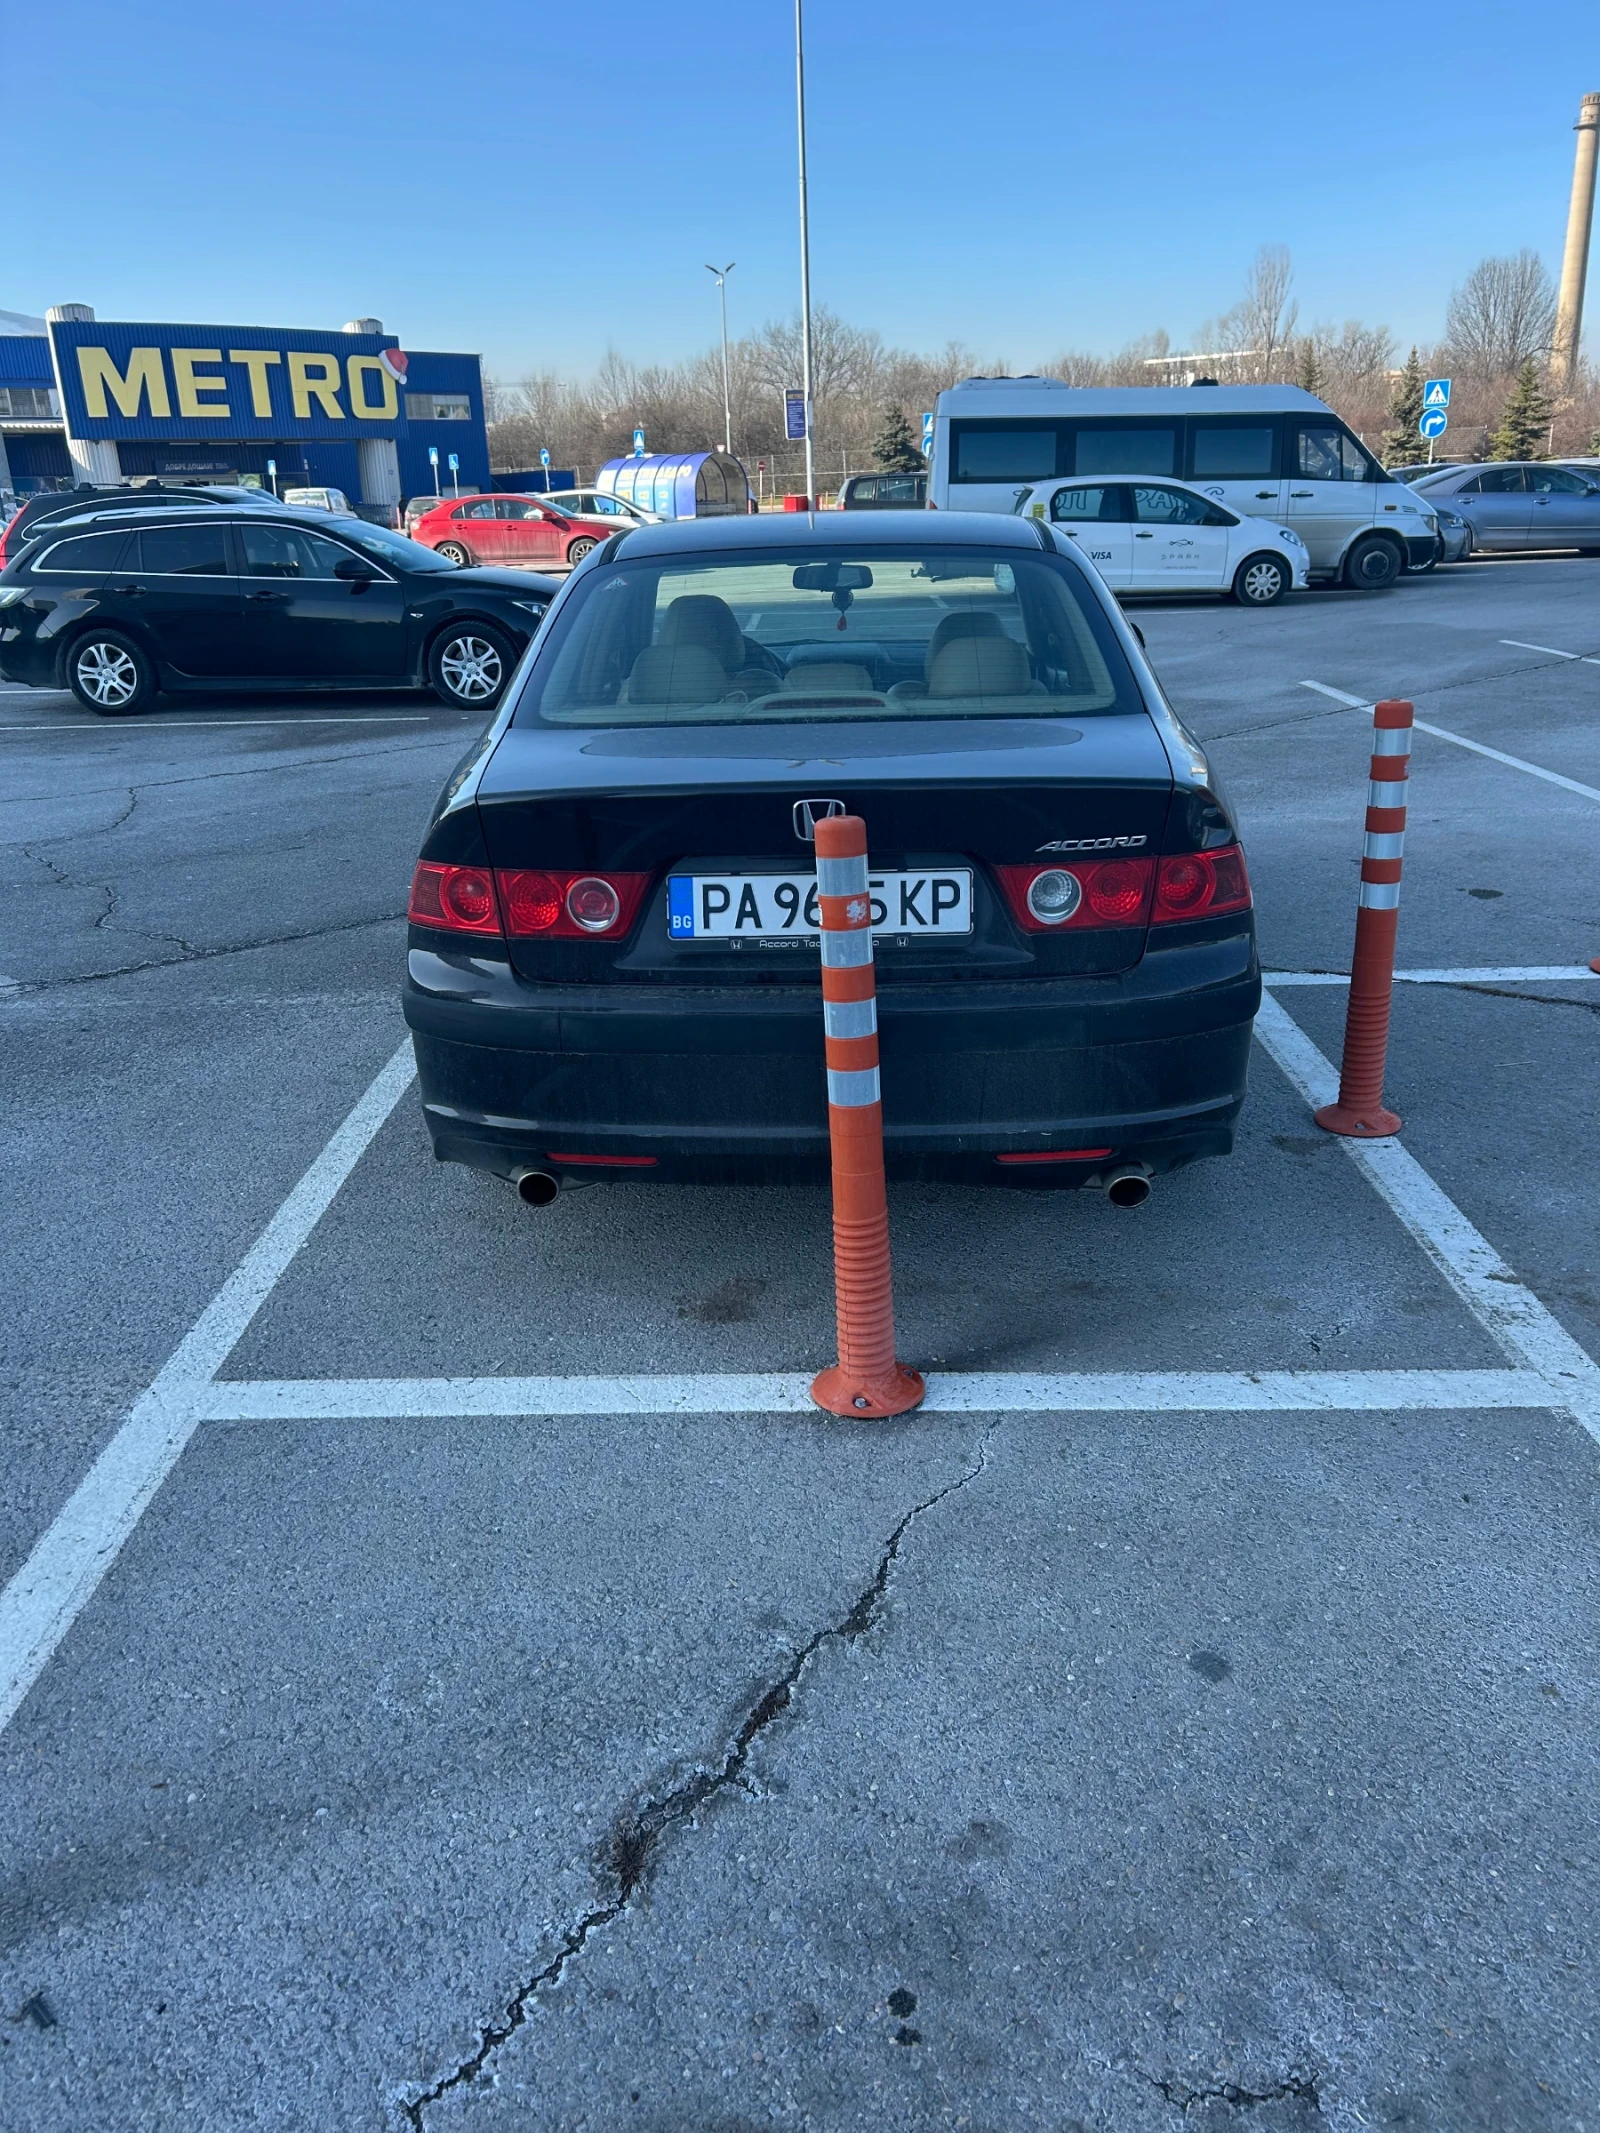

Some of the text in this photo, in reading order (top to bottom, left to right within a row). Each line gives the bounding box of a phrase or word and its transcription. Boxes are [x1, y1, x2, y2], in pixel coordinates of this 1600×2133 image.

[76, 346, 399, 420] METRO
[1090, 551, 1112, 560] VISA
[1034, 835, 1148, 852] ACCORD
[774, 881, 888, 929] 965
[672, 914, 692, 929] BG
[759, 939, 799, 948] Accord
